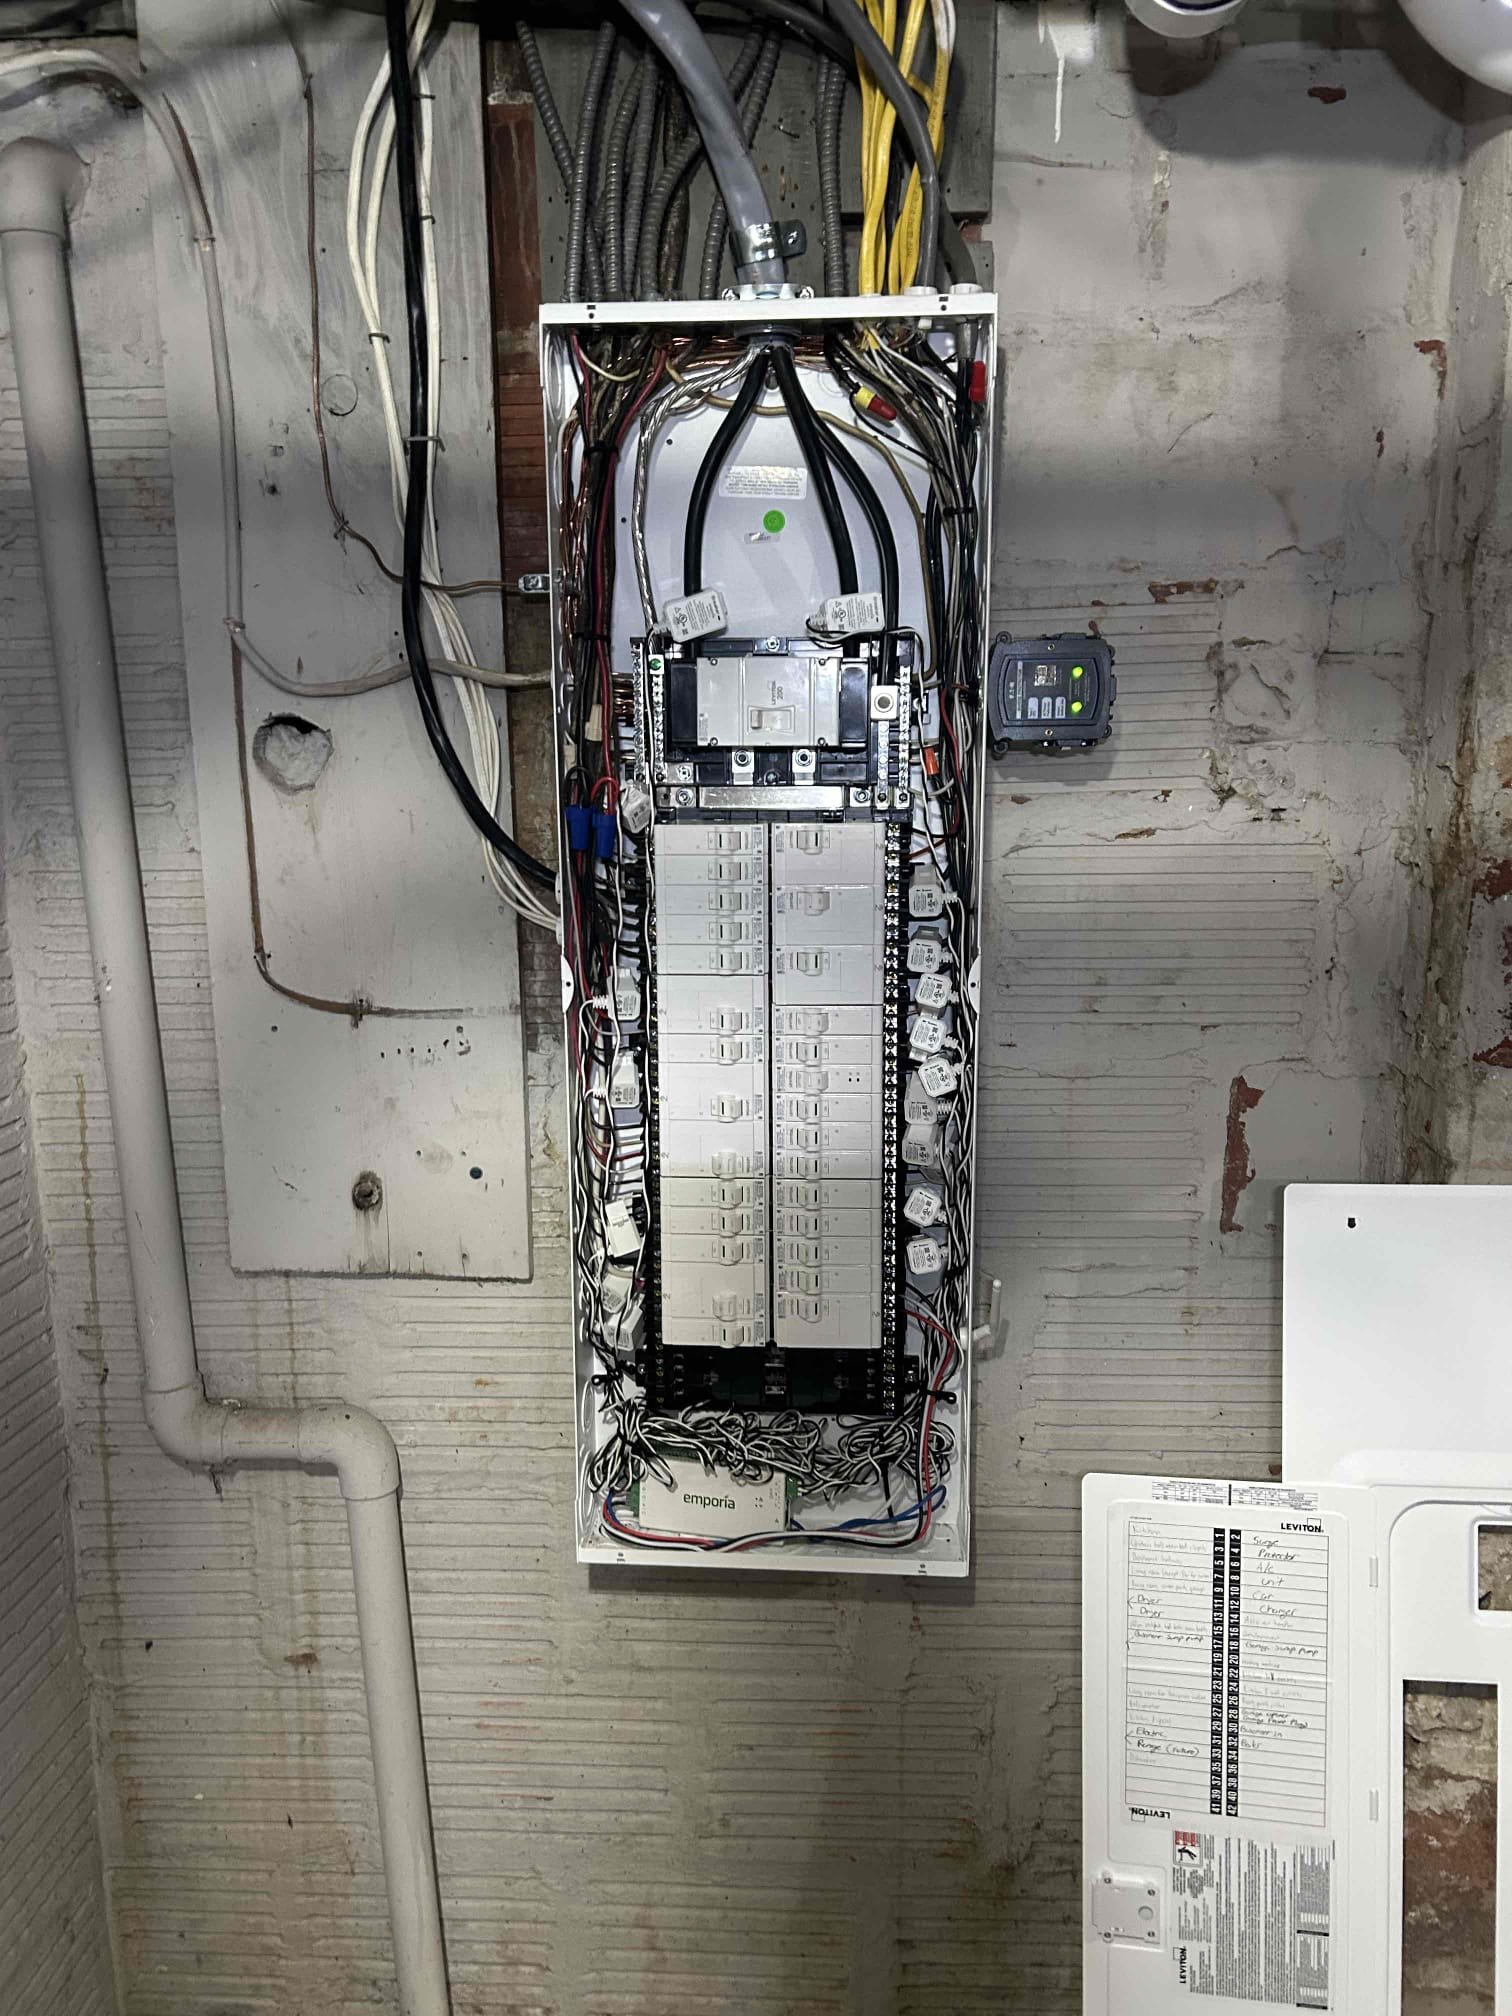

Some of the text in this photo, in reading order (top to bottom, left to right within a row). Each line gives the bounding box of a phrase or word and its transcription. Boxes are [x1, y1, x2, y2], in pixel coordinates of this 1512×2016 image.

[1281, 1523, 1322, 1533] LEVITON
[1230, 1586, 1239, 1596] 10
[1138, 1594, 1163, 1605] Dryer
[1214, 1599, 1223, 1609] 11
[1230, 1600, 1239, 1609] 12
[1140, 1607, 1164, 1618] Dryer
[1214, 1612, 1222, 1621] 13
[1230, 1614, 1239, 1623] 14
[1214, 1625, 1222, 1635] 15
[1230, 1627, 1238, 1636] 16
[1213, 1639, 1222, 1649] 17
[1230, 1641, 1238, 1650] 18
[1213, 1653, 1222, 1662] 19
[1229, 1654, 1238, 1665] 20
[1213, 1667, 1222, 1677] 21
[1229, 1668, 1238, 1678] 22
[1213, 1680, 1222, 1690] 23
[1229, 1682, 1238, 1692] 24
[1213, 1694, 1222, 1704] 25
[1229, 1695, 1238, 1706] 26
[1212, 1707, 1222, 1717] 27
[1229, 1709, 1238, 1719] 28
[1212, 1721, 1222, 1731] 29
[1228, 1722, 1238, 1733] 30
[1212, 1735, 1221, 1745] 31
[1228, 1736, 1237, 1747] 32
[1212, 1748, 1221, 1758] 33
[1228, 1750, 1237, 1760] 34
[1212, 1762, 1221, 1772] 35
[1228, 1764, 1237, 1774] 36
[1212, 1775, 1221, 1786] 37
[1228, 1777, 1237, 1788] 38
[1212, 1789, 1220, 1799] 39
[1228, 1791, 1237, 1801] 40
[1132, 1807, 1170, 1819] LEVITON
[1212, 1803, 1220, 1813] 41
[1228, 1805, 1236, 1815] 42
